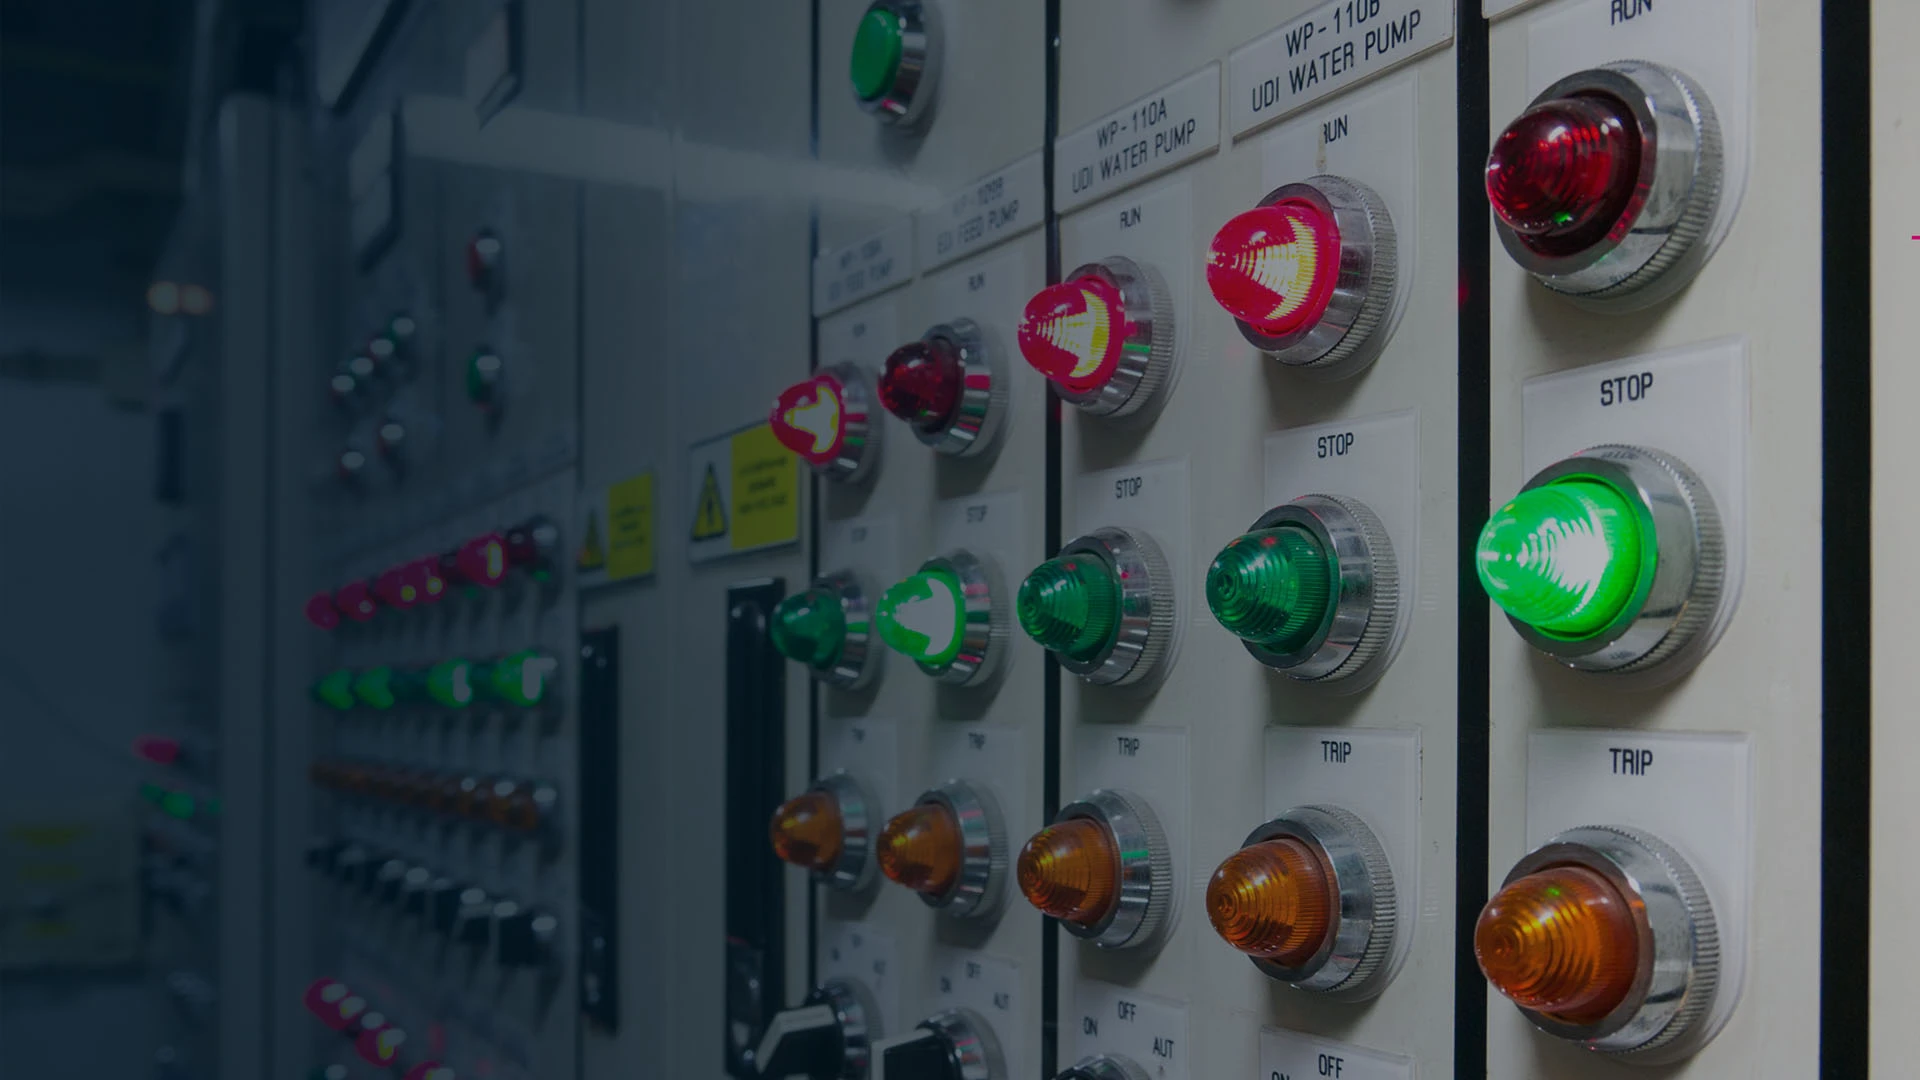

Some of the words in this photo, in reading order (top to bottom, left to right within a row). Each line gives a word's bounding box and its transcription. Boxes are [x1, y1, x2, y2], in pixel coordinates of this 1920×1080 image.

[1252, 76, 1280, 112] UDI
[1289, 41, 1354, 95] WATER
[1365, 9, 1421, 61] PUMP
[1072, 165, 1094, 194] UDI
[1100, 140, 1148, 180] WATER
[1155, 118, 1196, 158] PUMP
[1120, 204, 1142, 230] RUN
[1601, 372, 1653, 407] STOP
[1317, 432, 1354, 459] STOP
[1115, 476, 1142, 499] STOP
[1117, 736, 1140, 756] TRIP
[1321, 741, 1351, 763] TRIP
[1609, 747, 1653, 776] TRIP
[1118, 1000, 1136, 1022] OFF
[1083, 1016, 1098, 1037] ON
[1153, 1036, 1174, 1059] AUT
[1318, 1053, 1344, 1079] OFF
